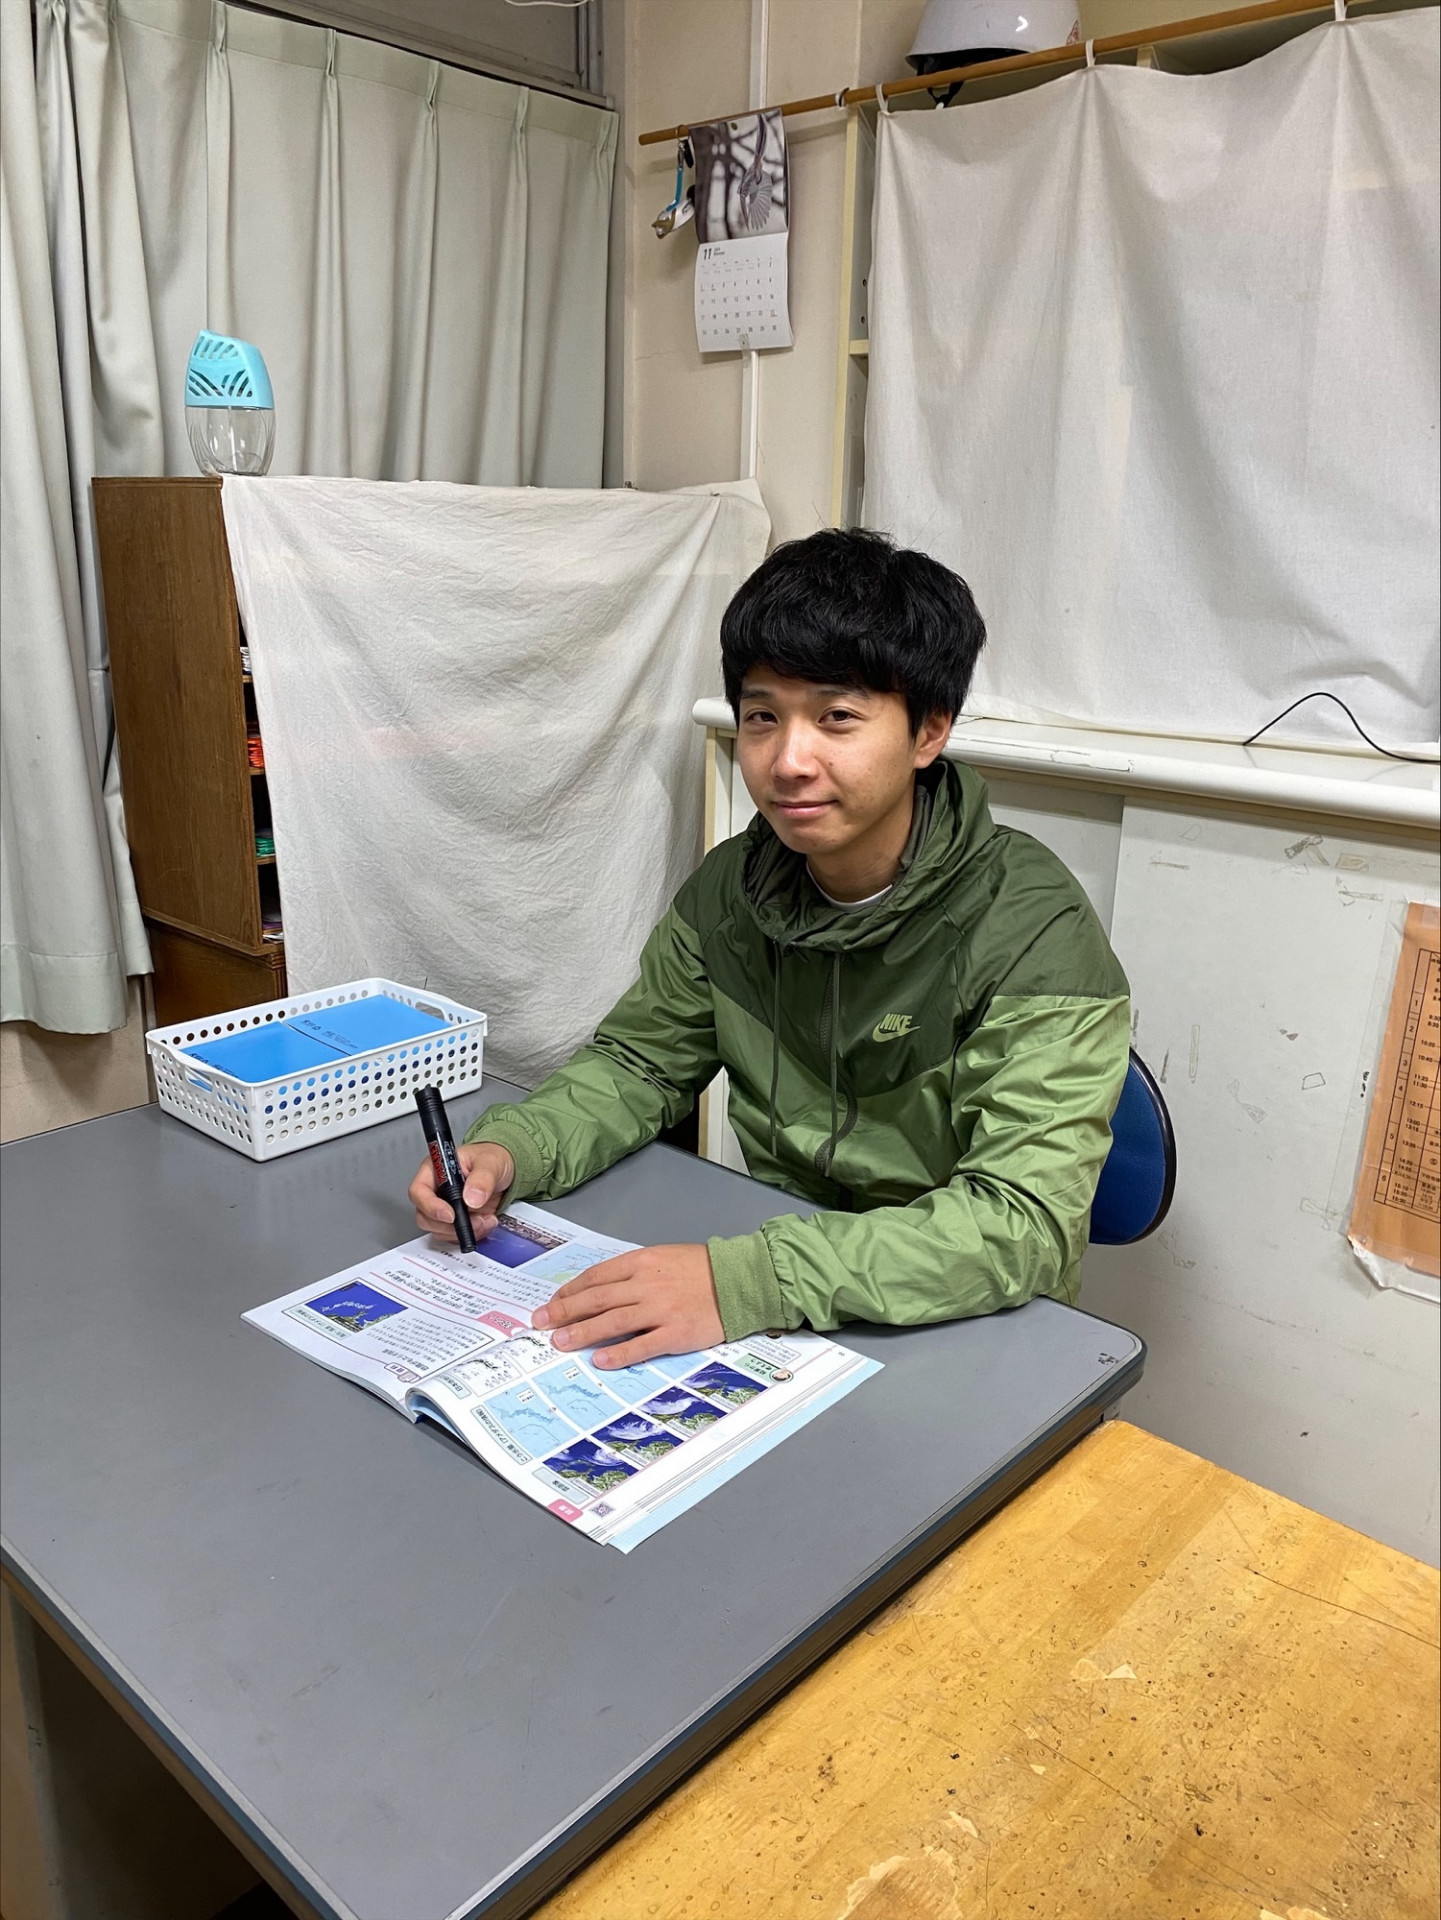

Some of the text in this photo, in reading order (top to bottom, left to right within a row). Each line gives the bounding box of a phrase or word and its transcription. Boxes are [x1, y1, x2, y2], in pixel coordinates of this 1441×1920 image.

[704, 248, 712, 260] 11
[880, 1013, 912, 1032] NIKE
[1409, 1100, 1424, 1109] 12:15
[1407, 1118, 1420, 1126] 13:00
